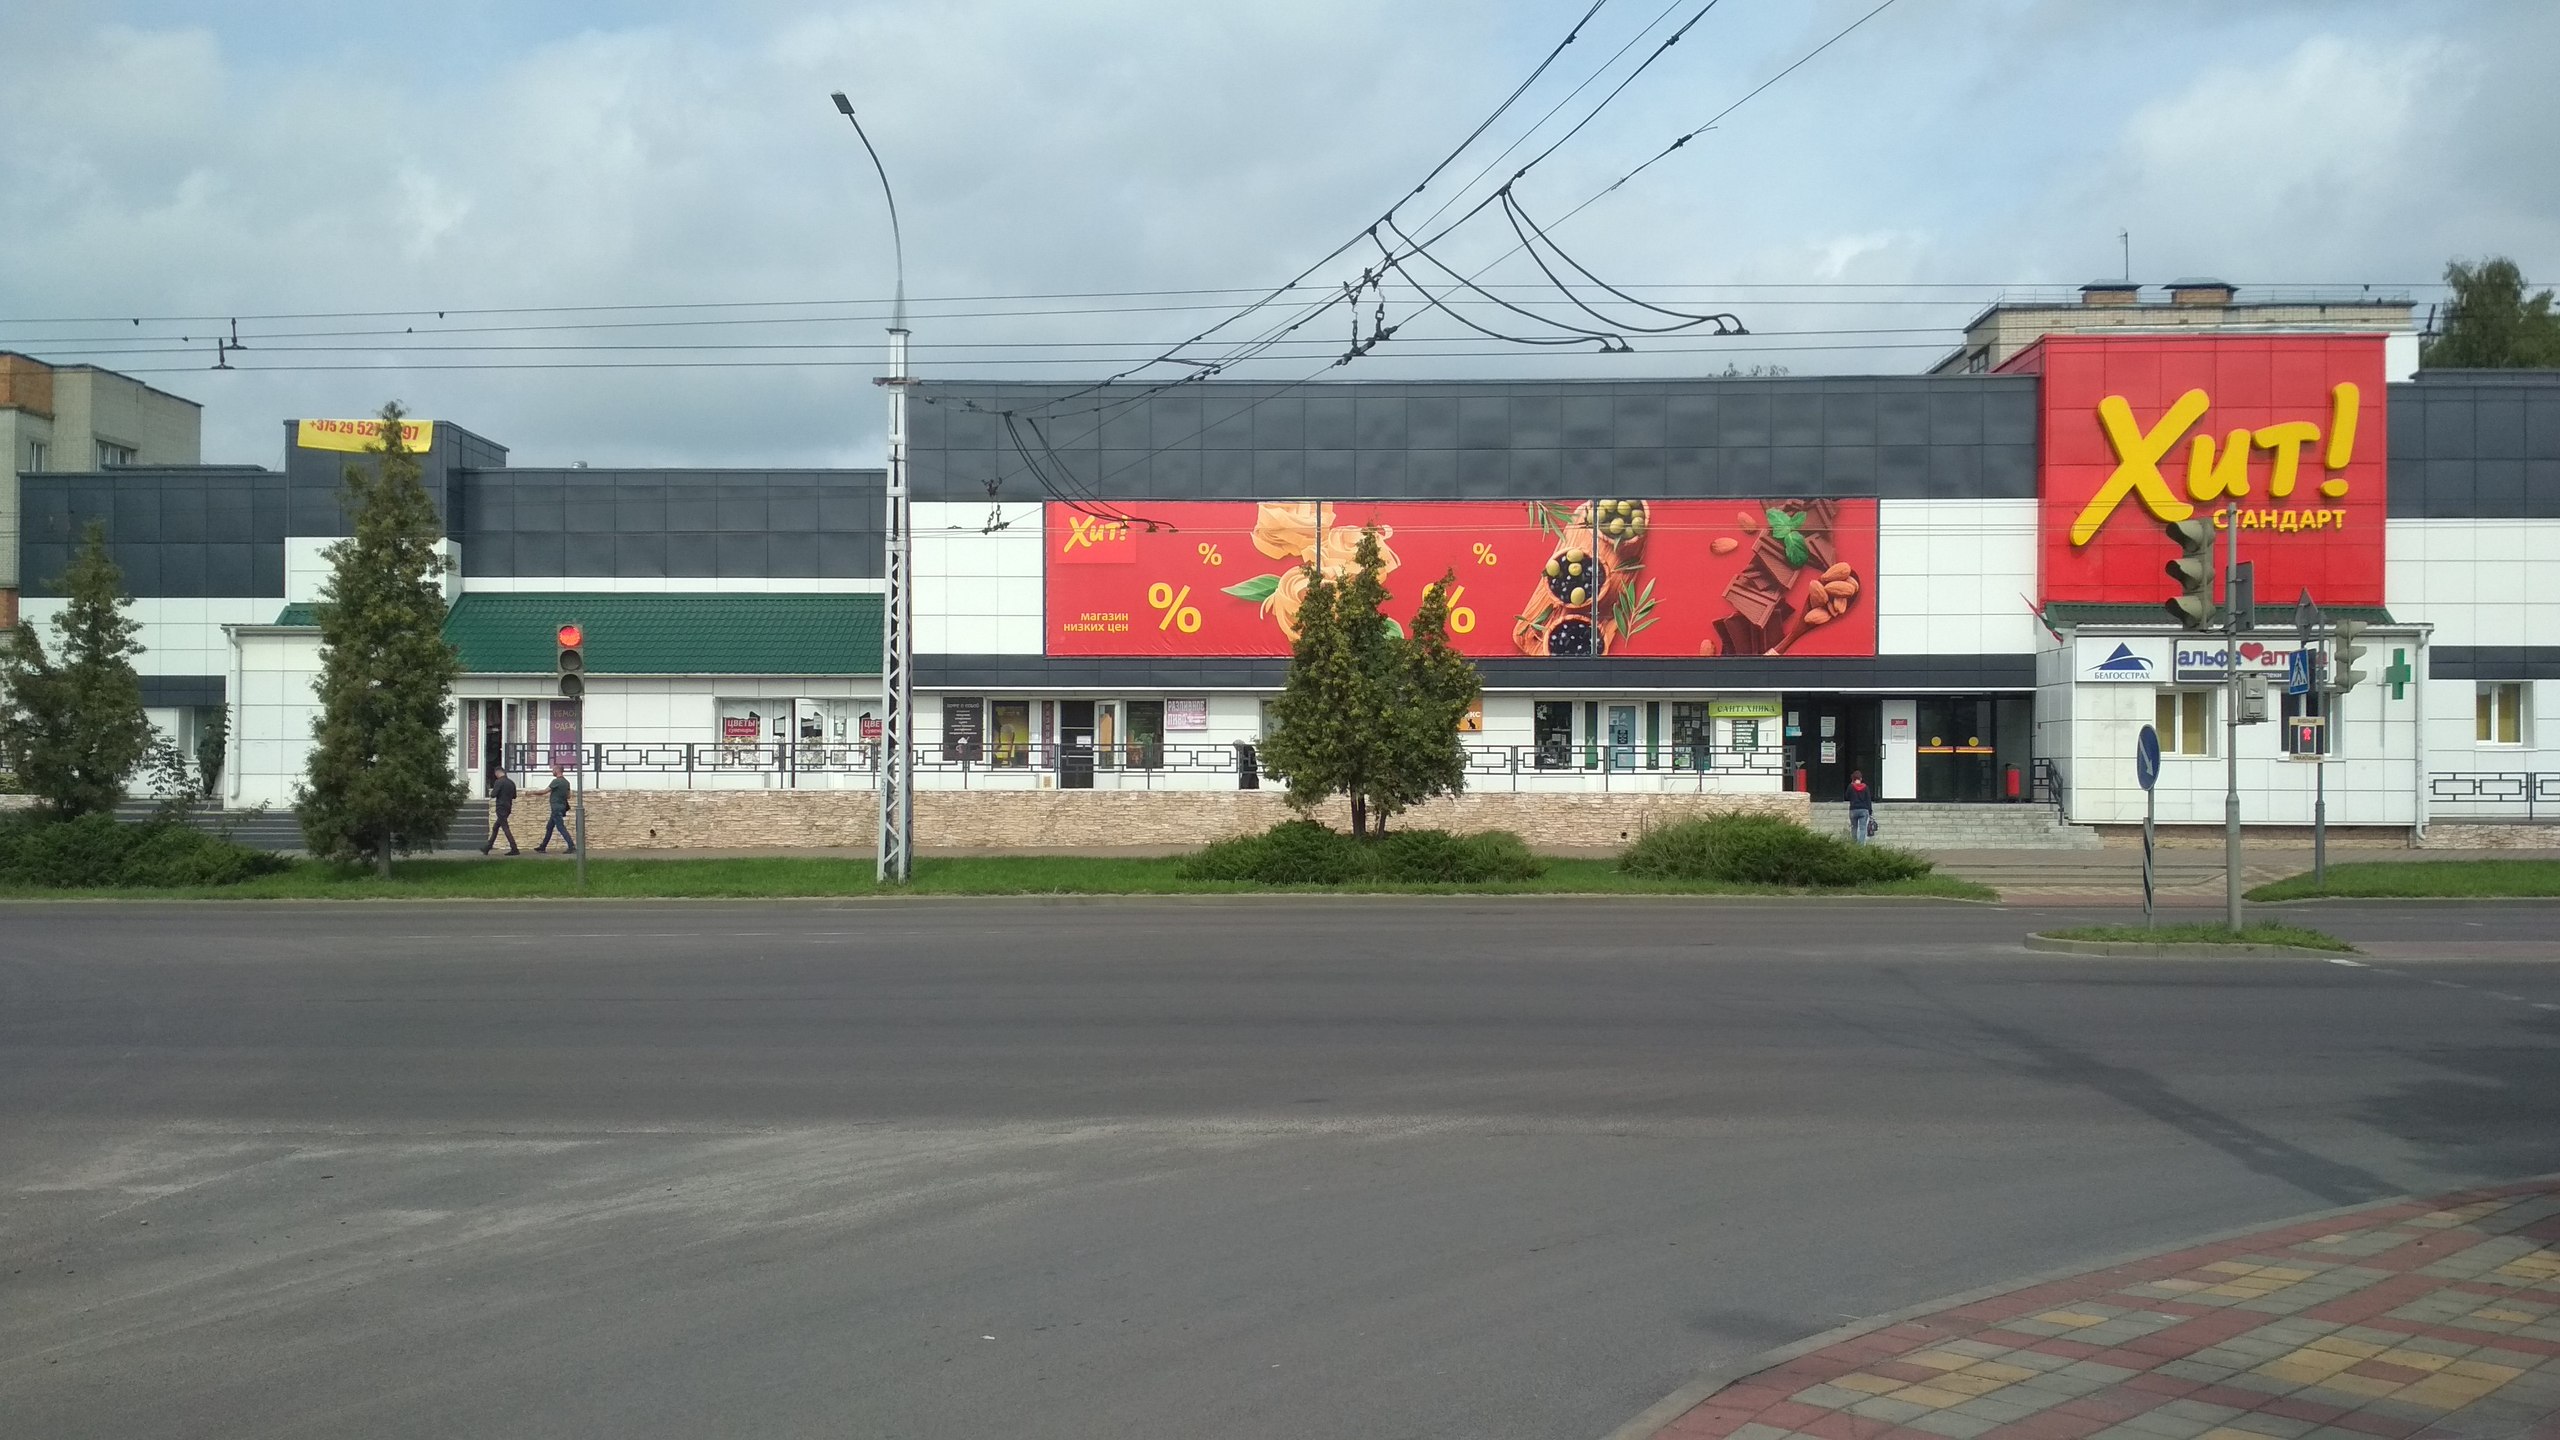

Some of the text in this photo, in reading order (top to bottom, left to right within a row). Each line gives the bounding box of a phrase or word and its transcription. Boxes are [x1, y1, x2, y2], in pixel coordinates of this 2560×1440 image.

[309, 419, 337, 432] +375
[340, 421, 353, 433] 29
[2070, 382, 2360, 546] Хит!
[1063, 515, 1128, 553] Хит!
[1081, 613, 1129, 622] магазин
[1063, 623, 1129, 634] низких цен
[2094, 671, 2151, 680] БЕЛГОССТРАХ
[1167, 700, 1205, 712] РАЗЛИВНОЕ
[1717, 705, 1776, 713] САНТЕХНИКА
[727, 719, 756, 728] ЦВЕТЫ
